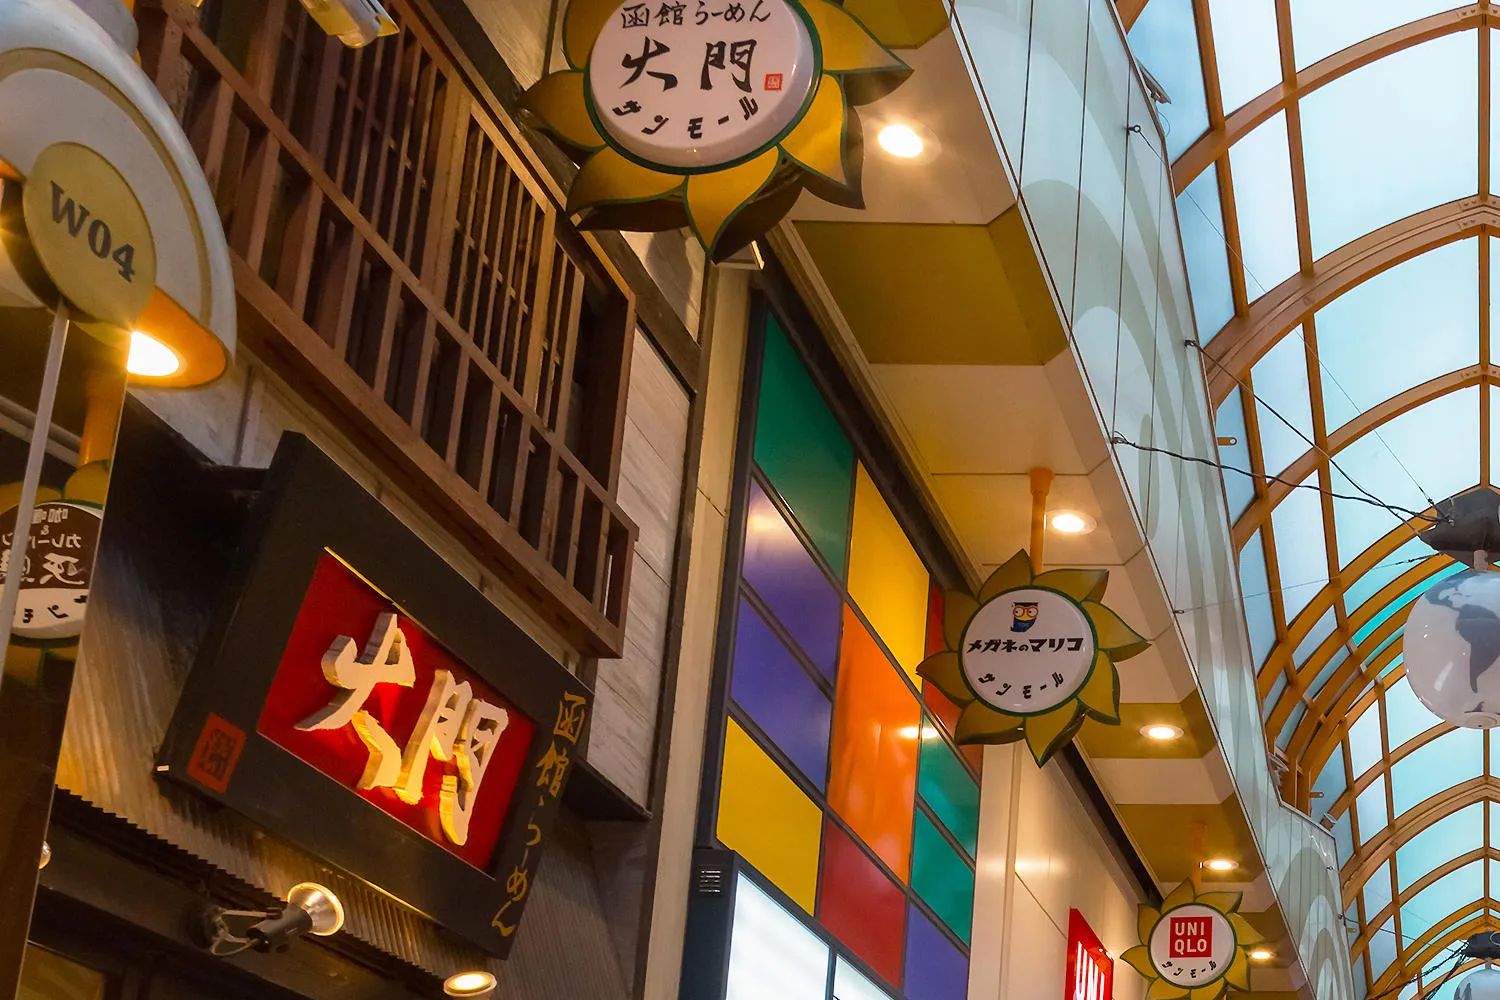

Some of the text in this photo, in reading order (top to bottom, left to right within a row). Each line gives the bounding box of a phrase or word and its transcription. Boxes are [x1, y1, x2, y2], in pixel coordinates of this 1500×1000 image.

[621, 1, 772, 28] 函館らーめん
[620, 36, 758, 93] 大門
[612, 96, 759, 139] サンモール
[49, 179, 137, 283] W04
[966, 638, 1084, 654] メガネのマリコ
[979, 672, 1064, 699] サンモール
[294, 613, 509, 847] 大門
[1175, 922, 1205, 937] UNI
[1174, 938, 1208, 956] QLO
[1162, 960, 1217, 979] サンモール
